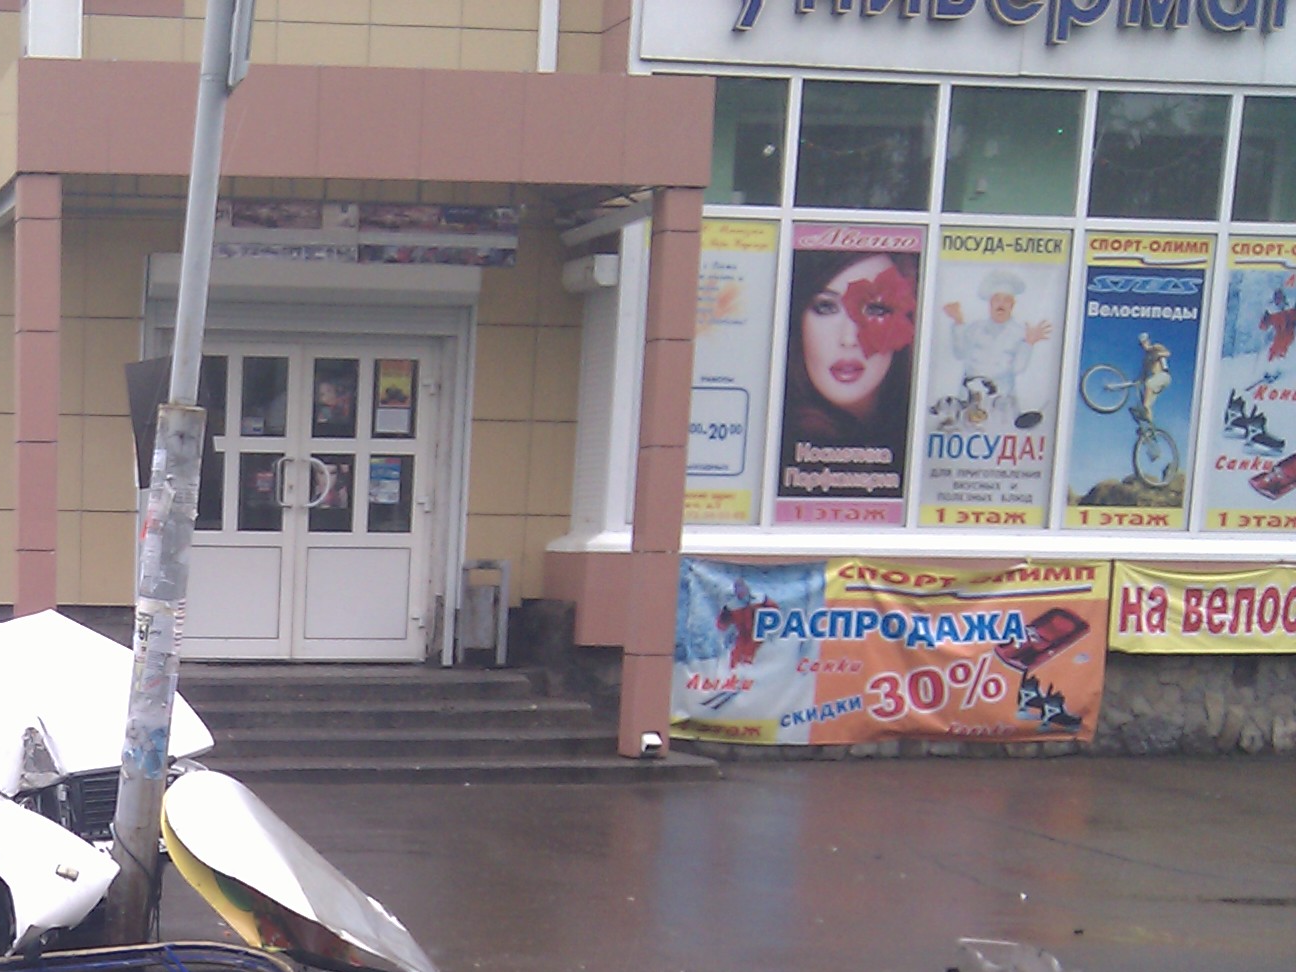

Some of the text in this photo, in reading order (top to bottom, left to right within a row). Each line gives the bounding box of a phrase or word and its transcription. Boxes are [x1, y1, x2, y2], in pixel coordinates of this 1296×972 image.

[943, 234, 1063, 255] ПОСУДА-БЛЕСК
[1089, 238, 1209, 254] СПОРТ-ОЛИМП
[1087, 300, 1198, 321] Велосипеды
[1254, 384, 1296, 401] Кон
[928, 434, 1046, 466] ПОСУДА!
[1214, 455, 1274, 472] Санки
[794, 505, 887, 521] 1 этаж
[935, 508, 1027, 525] 1 этаж
[1079, 510, 1170, 527] 1 этаж
[1218, 512, 1228, 527] 1
[838, 564, 957, 589] СПОРТ
[755, 608, 1027, 648] РАСПРОДАЖА
[686, 674, 754, 691] Лыжи
[868, 655, 1004, 720] 30%
